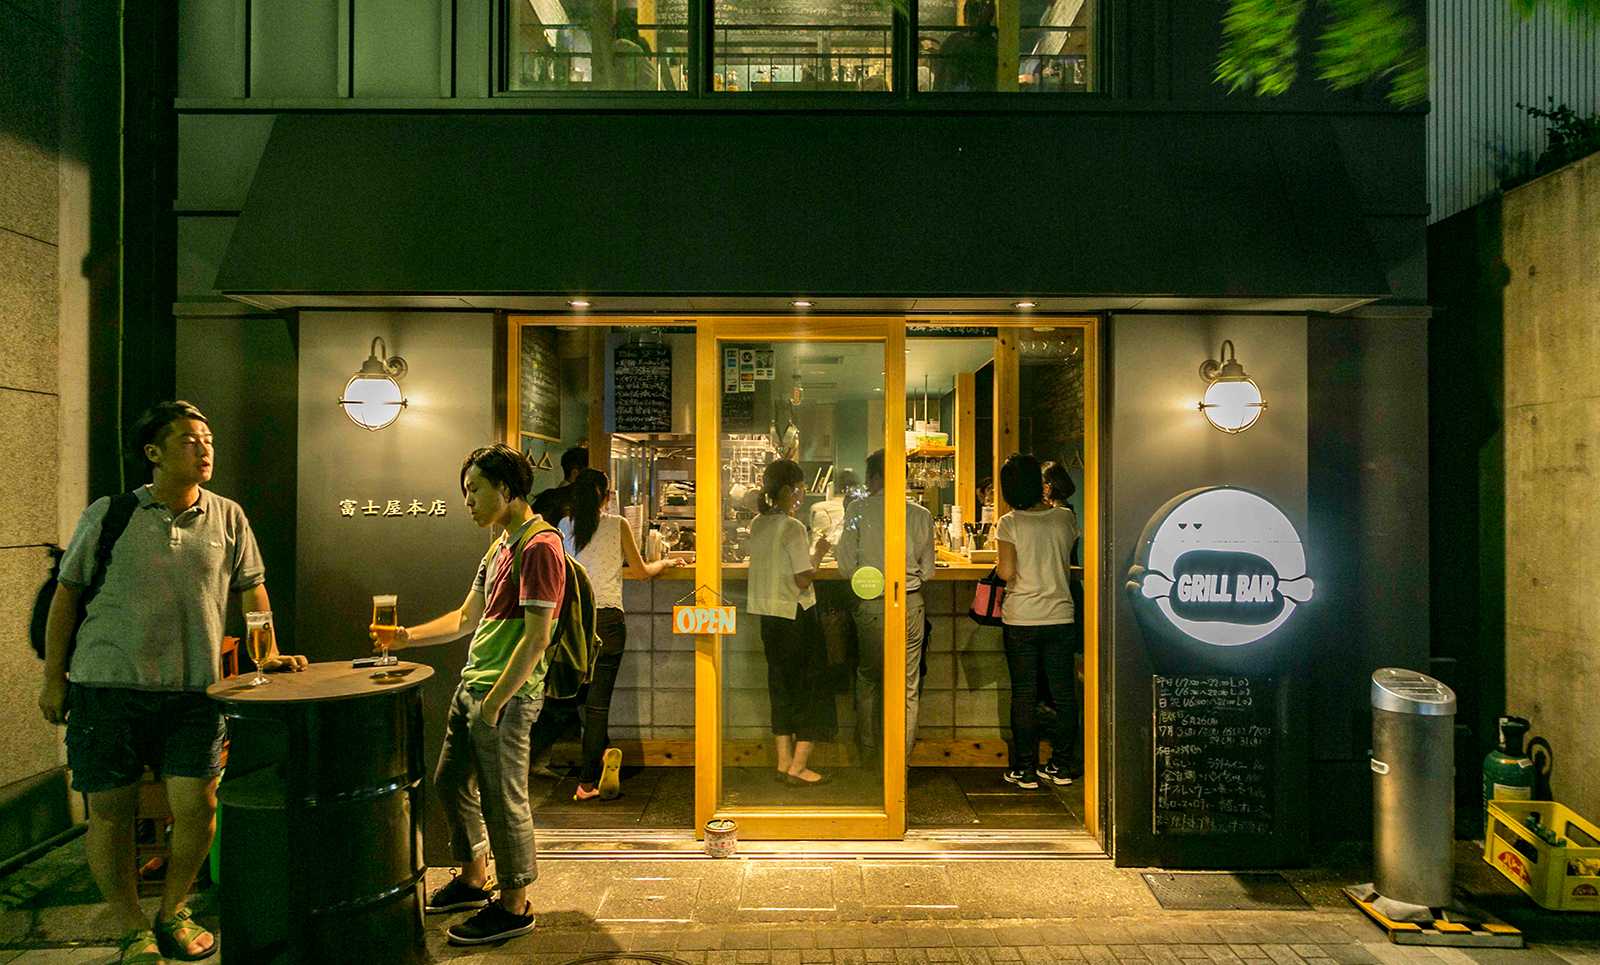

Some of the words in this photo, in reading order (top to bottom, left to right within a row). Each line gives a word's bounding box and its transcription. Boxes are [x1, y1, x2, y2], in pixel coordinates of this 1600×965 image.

[339, 499, 447, 517] 富士屋本店
[1177, 574, 1232, 602] GRILL
[1236, 574, 1275, 602] BAR
[676, 608, 735, 633] OPEN
